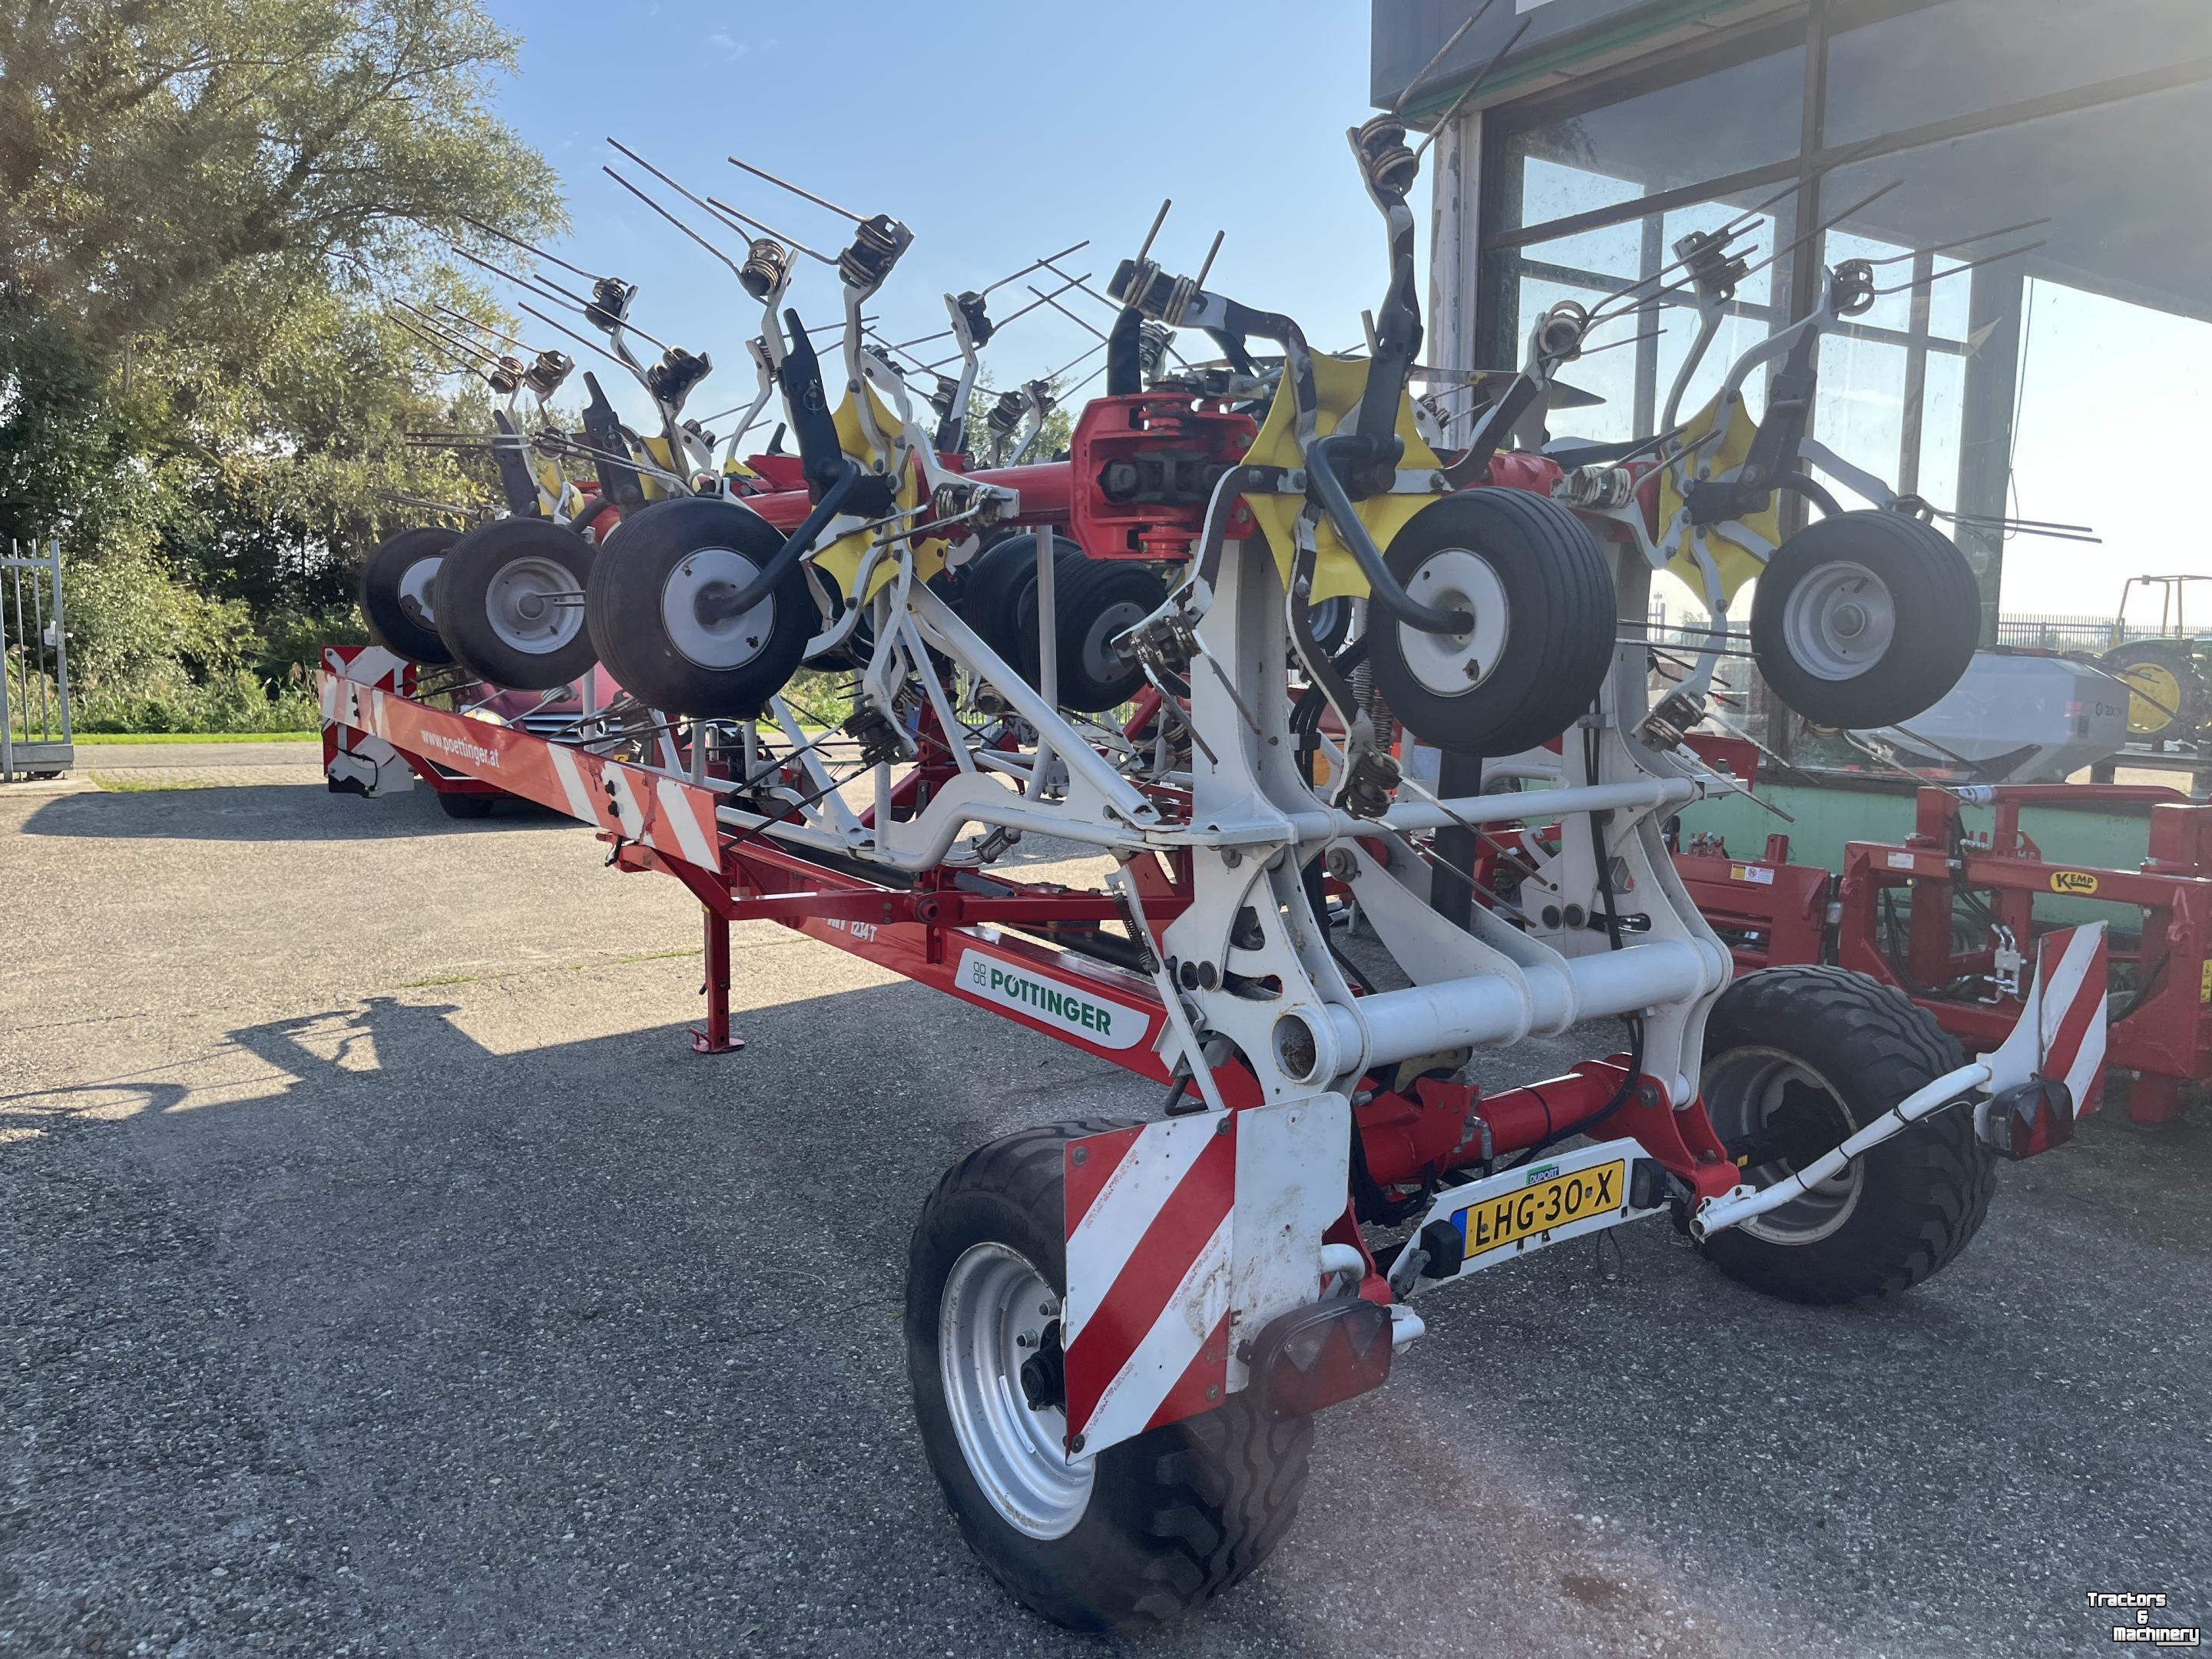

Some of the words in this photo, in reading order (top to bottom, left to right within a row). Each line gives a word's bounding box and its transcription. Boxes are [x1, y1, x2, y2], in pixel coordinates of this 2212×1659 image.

[420, 730, 500, 768] www.poettinger.at
[2055, 873, 2094, 890] KEMP
[1529, 1167, 1559, 1184] DUPORT
[1475, 1169, 1613, 1247] LHG-30-X
